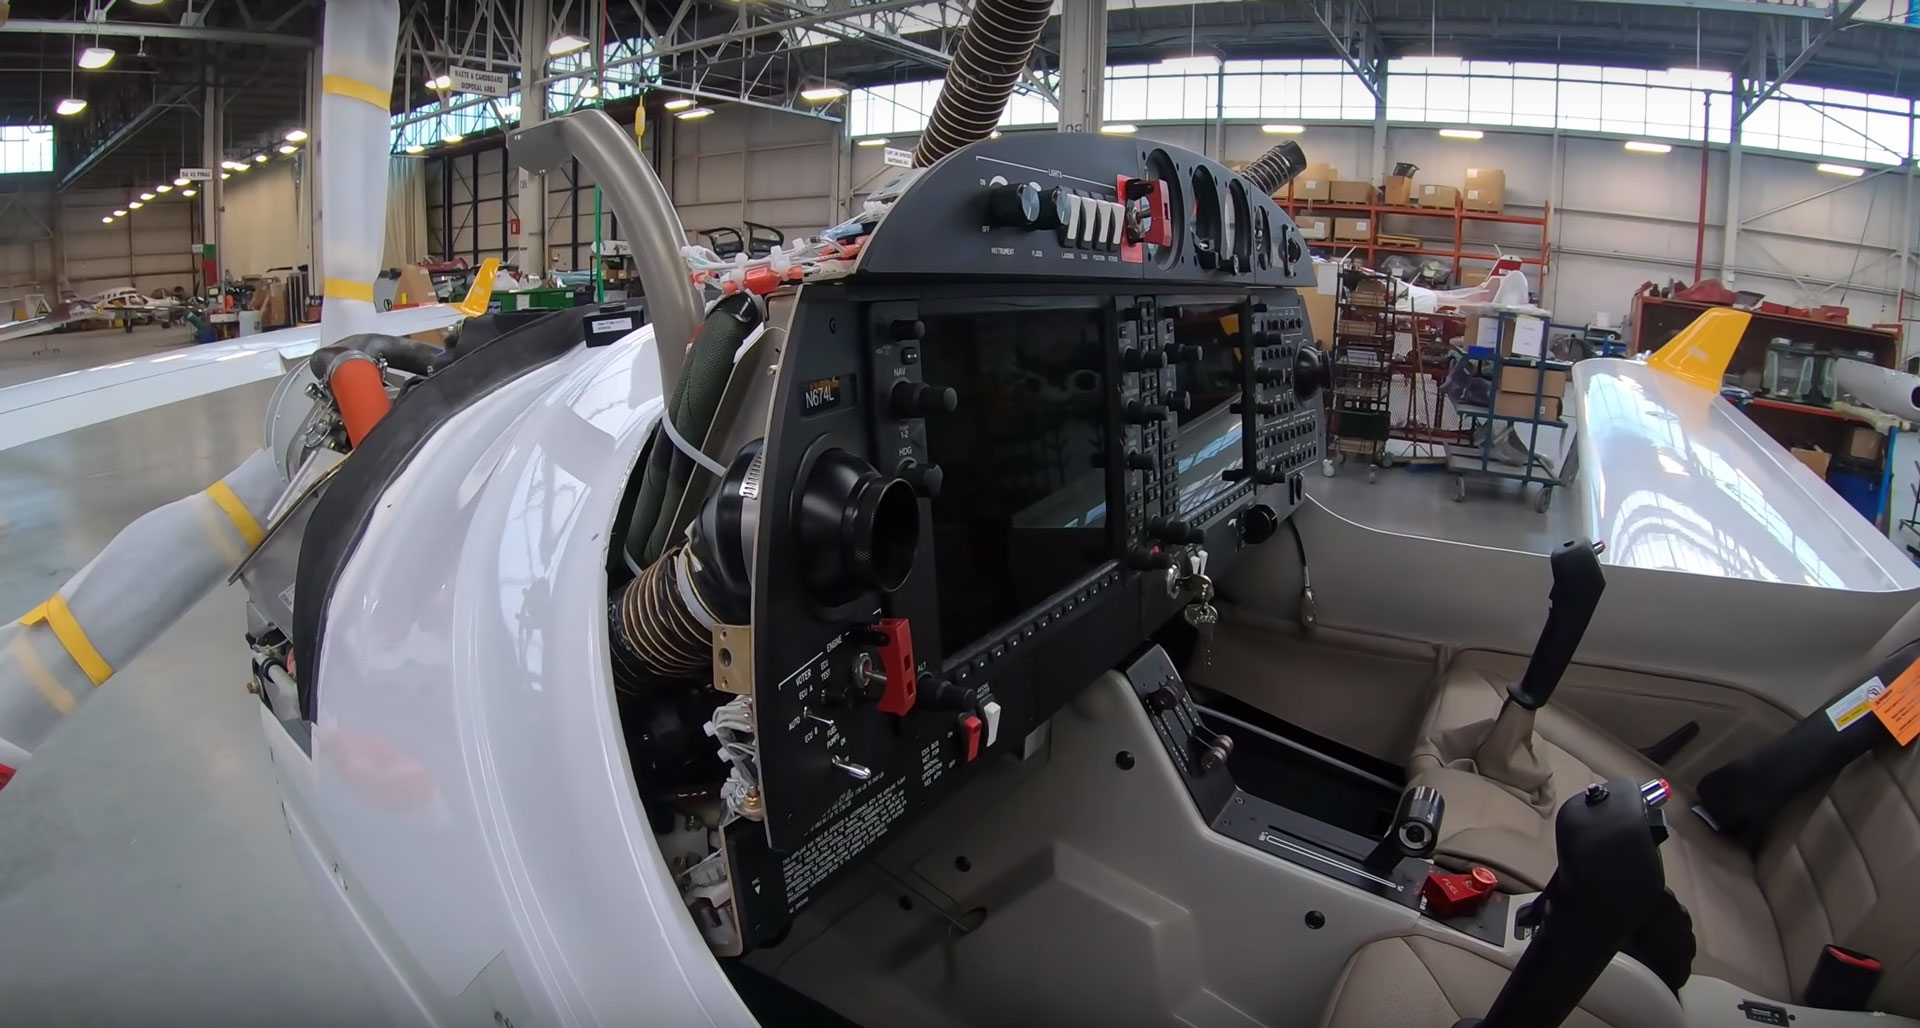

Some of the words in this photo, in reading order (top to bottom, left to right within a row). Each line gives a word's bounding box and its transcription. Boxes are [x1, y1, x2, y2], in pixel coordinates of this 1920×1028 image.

[455, 70, 469, 80] WASTE
[476, 73, 503, 84] CARDBOARD
[461, 82, 482, 92] DISPOSAL
[1048, 168, 1062, 178] LIGHTS
[894, 368, 906, 377] NAV
[805, 384, 835, 408] N674L
[899, 446, 912, 456] HDG
[826, 634, 842, 652] ENGINE
[820, 659, 829, 671] ECU
[918, 661, 926, 672] ALT
[796, 668, 812, 686] VOTER
[821, 668, 830, 681] TEST
[799, 688, 808, 700] ECU
[789, 716, 800, 731] AUTO
[805, 731, 813, 743] ECU
[1441, 878, 1459, 895] FUEL
